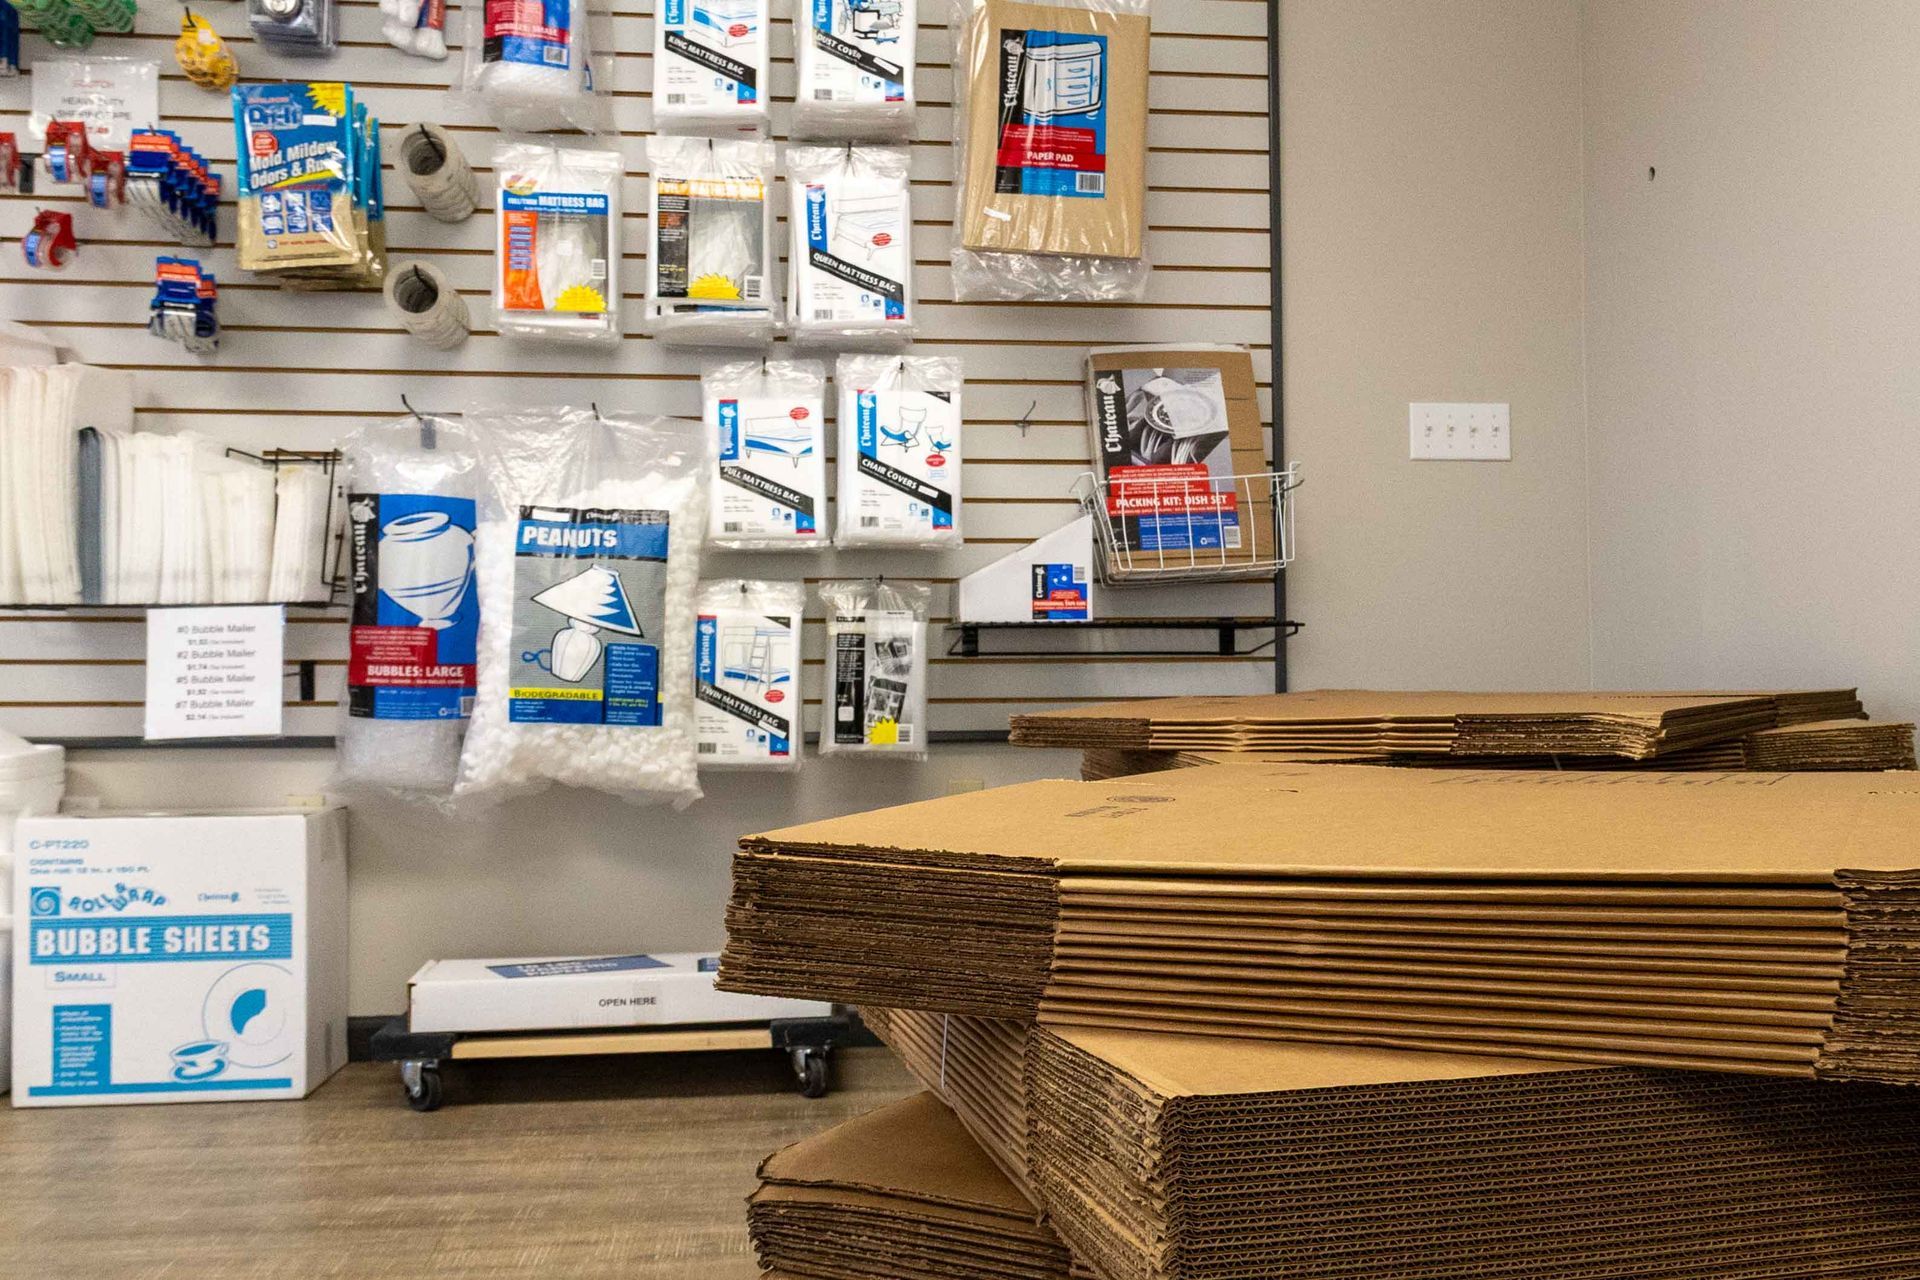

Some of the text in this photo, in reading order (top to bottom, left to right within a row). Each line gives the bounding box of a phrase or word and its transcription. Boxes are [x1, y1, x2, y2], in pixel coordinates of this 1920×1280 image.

[668, 35, 745, 75] KING MATTRESS BAG
[816, 33, 862, 59] DUST COVER
[1004, 54, 1018, 107] Chateau
[1026, 151, 1074, 163] PAPER PAD
[251, 169, 288, 190] Odors
[291, 160, 303, 177] &
[538, 195, 585, 208] MATTRESS
[586, 197, 605, 208] BAG
[811, 203, 822, 241] Chateau
[813, 252, 896, 293] QUEEN MATTRESS BAG
[860, 408, 872, 447] Chateau
[1104, 395, 1123, 454] Chateau
[723, 466, 801, 504] FULL MATTRESS BAG
[861, 458, 918, 490] CHAIR COVERS
[1115, 495, 1228, 509] PACKING KIT: DISH SET
[522, 526, 619, 548] PEANUTS
[355, 523, 370, 595] Chateau
[191, 624, 225, 634] Bubble
[227, 623, 257, 633] Mailer
[191, 650, 225, 659] Bubble
[227, 649, 257, 658] Mailer
[699, 634, 711, 673] Chateau
[190, 675, 224, 684] Bubble
[226, 673, 256, 683] Mailer
[367, 665, 464, 677] BUBBLES: LARGE
[189, 700, 223, 709] Bubble
[225, 698, 256, 708] Mailer
[514, 689, 599, 699] BIODEGRADABLE
[700, 686, 779, 728] TWIN MATTRESS BAG
[29, 840, 90, 849] C-PT220
[68, 893, 114, 912] ROLL
[112, 887, 167, 912] WRAP
[36, 925, 270, 957] BUBBLE SHEETS
[599, 997, 657, 1008] OPEN HERE
